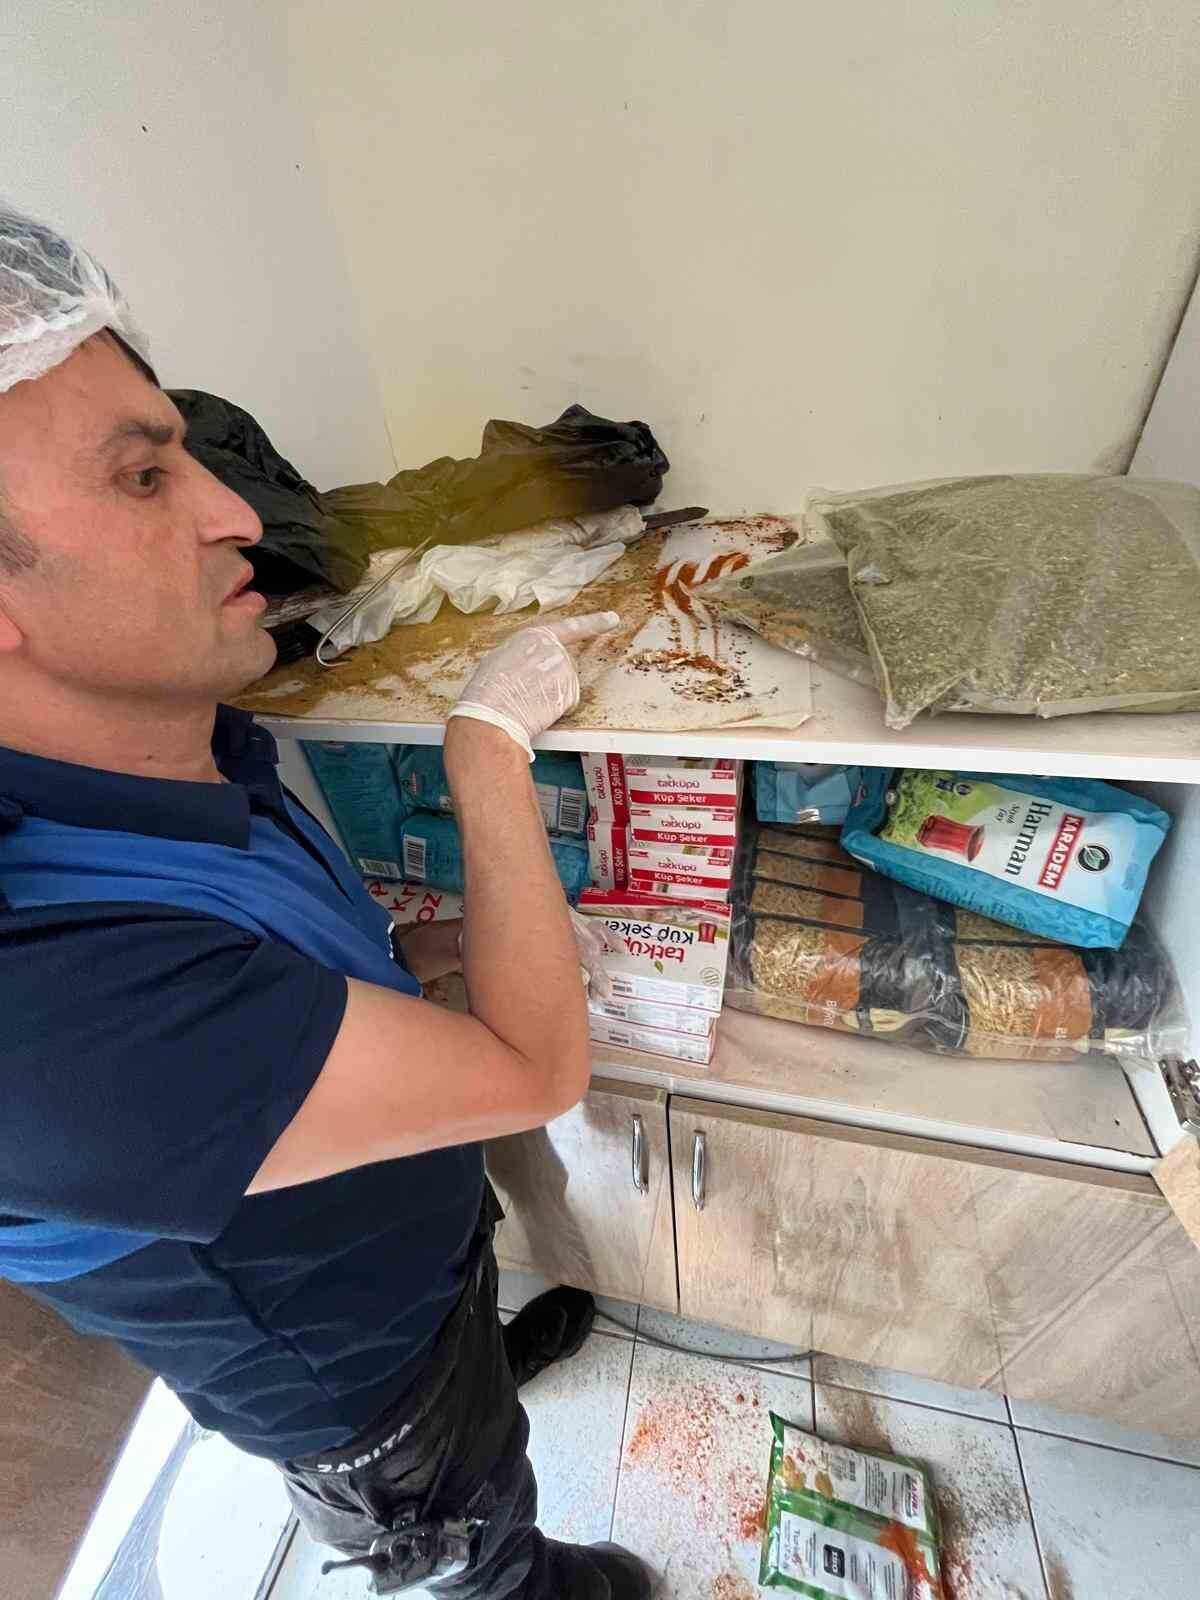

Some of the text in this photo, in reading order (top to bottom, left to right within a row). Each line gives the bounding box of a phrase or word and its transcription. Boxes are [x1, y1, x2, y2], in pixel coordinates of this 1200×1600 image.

[657, 777, 700, 789] tatküpü
[653, 793, 674, 803] Küp
[661, 818, 701, 829] tatküpü
[657, 832, 677, 843] Küp
[1005, 801, 1052, 876] Harman
[1042, 816, 1082, 888] KARADEM
[658, 859, 697, 871] tatküpü
[654, 873, 673, 883] Küp
[657, 926, 694, 945] Küp
